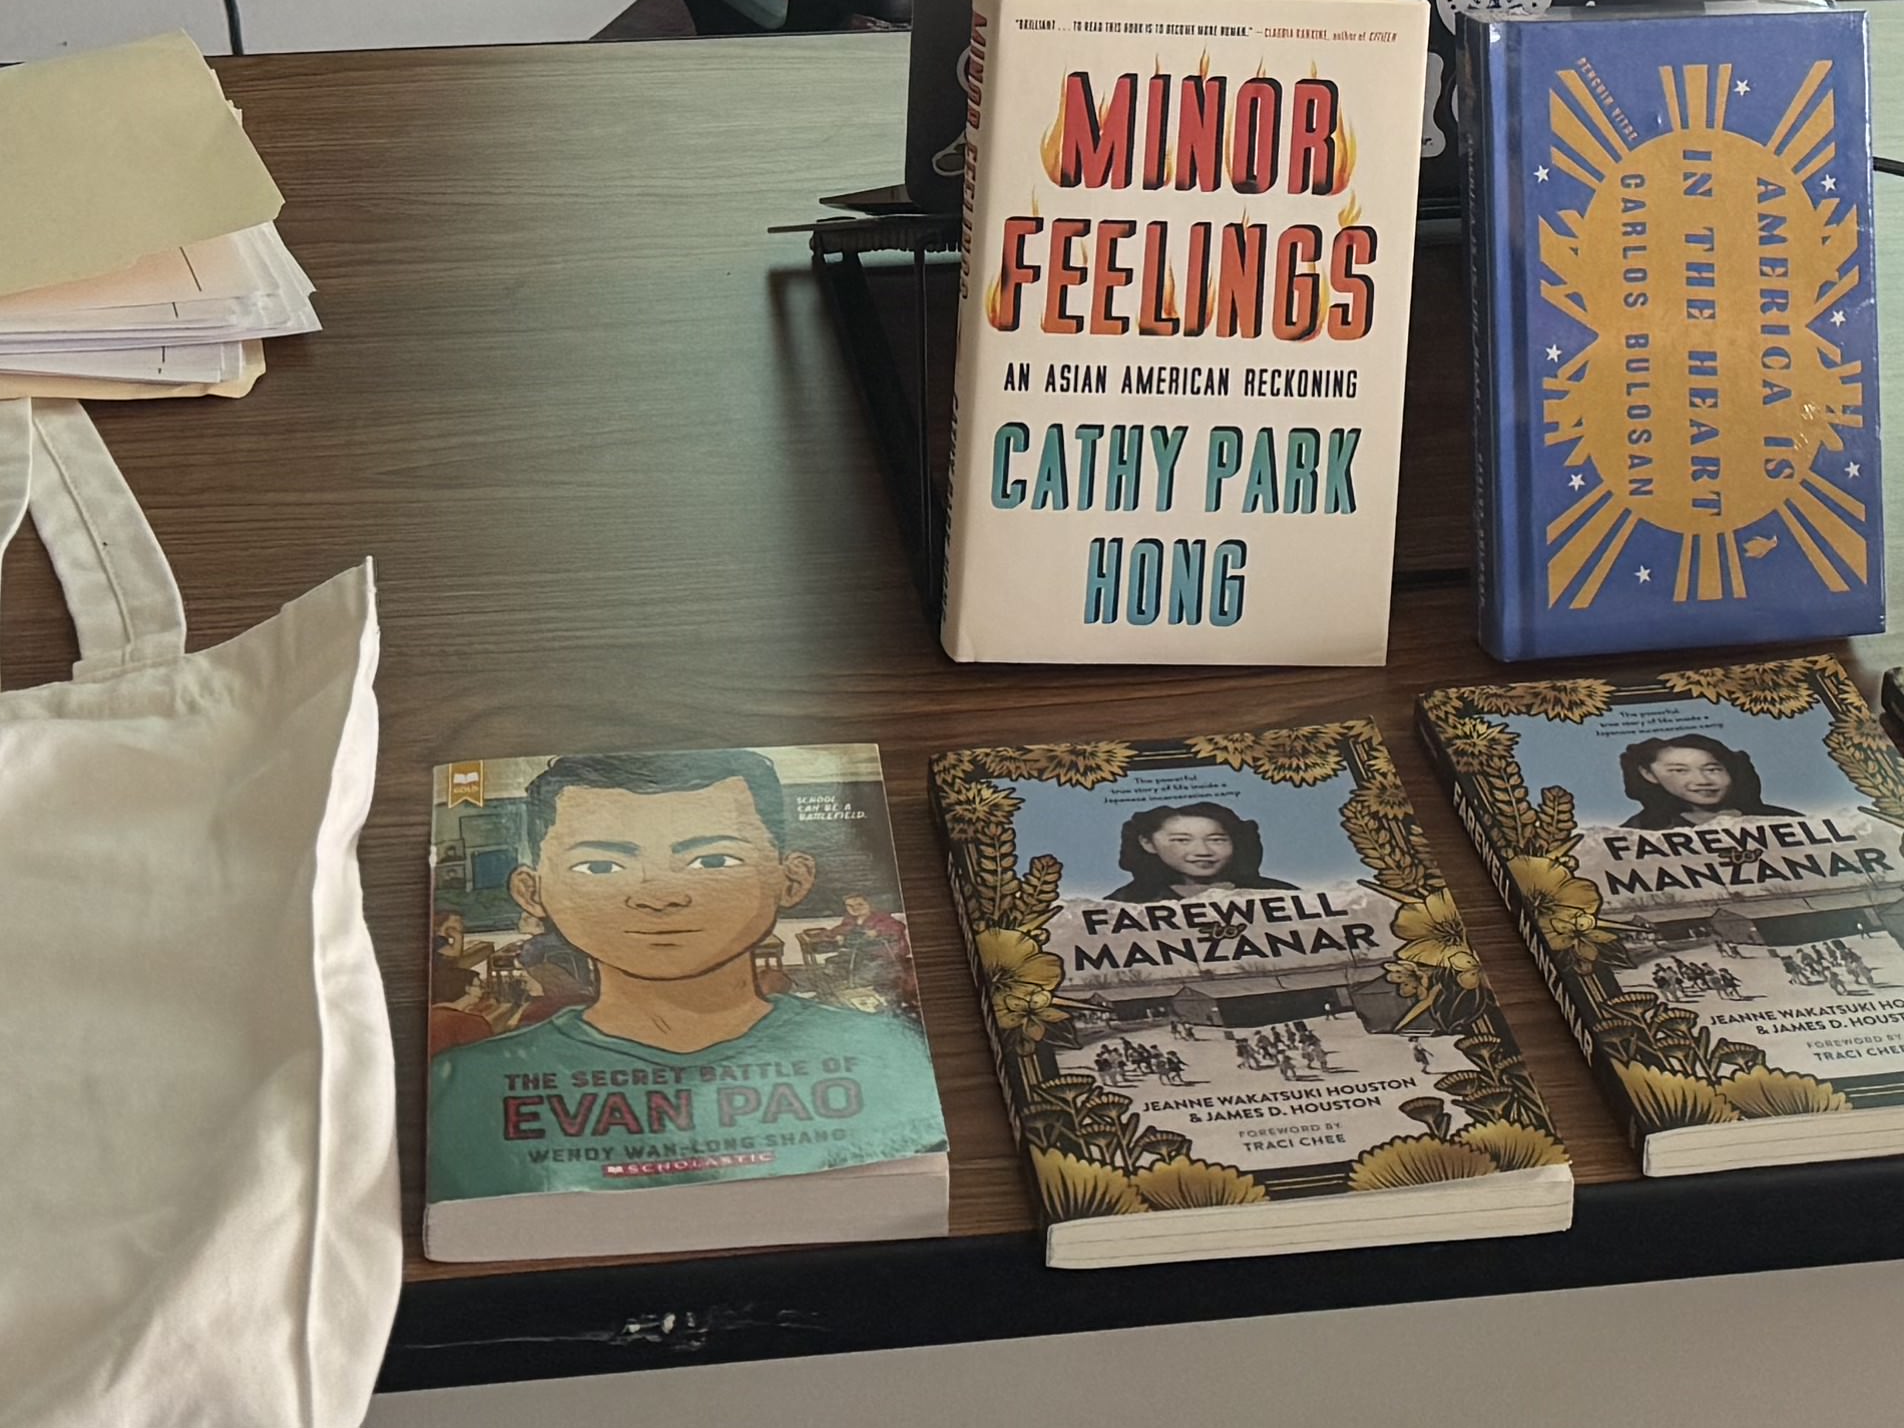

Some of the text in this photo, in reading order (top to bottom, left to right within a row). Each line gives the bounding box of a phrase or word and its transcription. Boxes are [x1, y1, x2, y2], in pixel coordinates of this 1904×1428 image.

[1059, 71, 1340, 197] MINOR
[995, 215, 1378, 343] FEELINGS
[1619, 172, 1654, 498] CARLOS BULOSAN
[1681, 148, 1722, 518] IN THE HEART
[1756, 175, 1795, 482] AMERICA IS
[1003, 362, 1358, 399] AN ASIAN AMERICAN RECKONING
[990, 422, 1363, 515] CATHY PARK
[1083, 536, 1248, 628] HONG
[844, 803, 852, 811] A
[1603, 818, 1858, 862] FAREWELL
[1605, 847, 1895, 895] MANZANAR
[1081, 892, 1349, 936] FAREWELL
[1452, 780, 1594, 1066] FAREWELL MANZANAR
[1074, 922, 1381, 972] MANZANAR
[1710, 1011, 1777, 1026] JEANNE
[1777, 1001, 1877, 1020] WAKATSUKI
[1756, 1025, 1770, 1035] &
[1772, 1019, 1827, 1035] JAMES
[1830, 1018, 1849, 1029] D.
[1806, 1035, 1883, 1050] FOREWORD
[1813, 1049, 1863, 1062] TRACI
[504, 1055, 860, 1092] THE SECRET BATTLE OF
[502, 1076, 865, 1141] EVAN PAO
[1142, 1077, 1418, 1113] JEANNE WAKATSUKI HOUSTON
[1189, 1096, 1382, 1123] & JAMES D. HOUSTON
[527, 1128, 847, 1165] WENDY WAN-LONG SHANG
[1238, 1121, 1343, 1138] FOREWORD BY
[1243, 1134, 1346, 1153] TRACI CHEE
[626, 1152, 774, 1175] SCHOLASTIC
